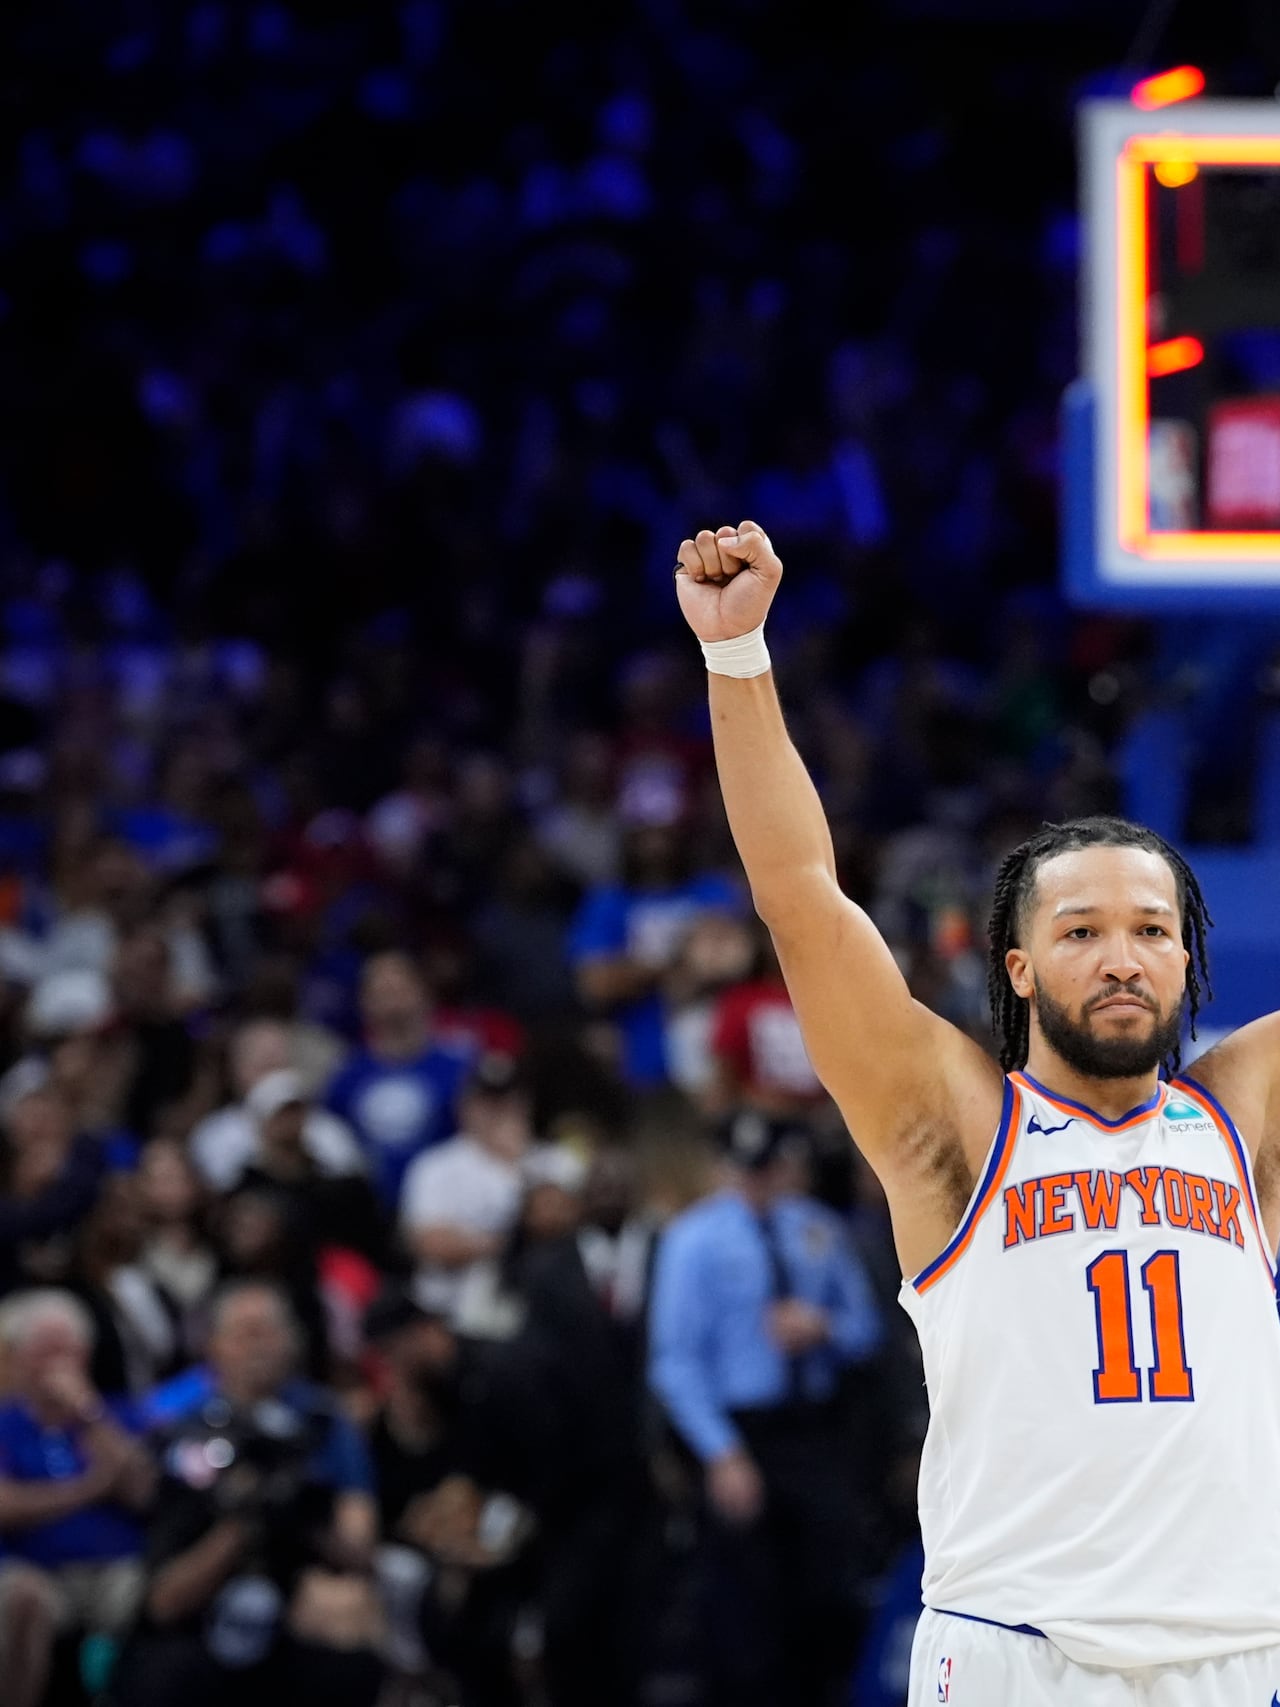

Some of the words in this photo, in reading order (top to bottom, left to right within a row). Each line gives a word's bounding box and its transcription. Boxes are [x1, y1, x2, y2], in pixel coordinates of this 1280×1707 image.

[1003, 1169, 1121, 1250] NEW
[1125, 1166, 1244, 1250] YORK
[1086, 1249, 1195, 1404] 11
